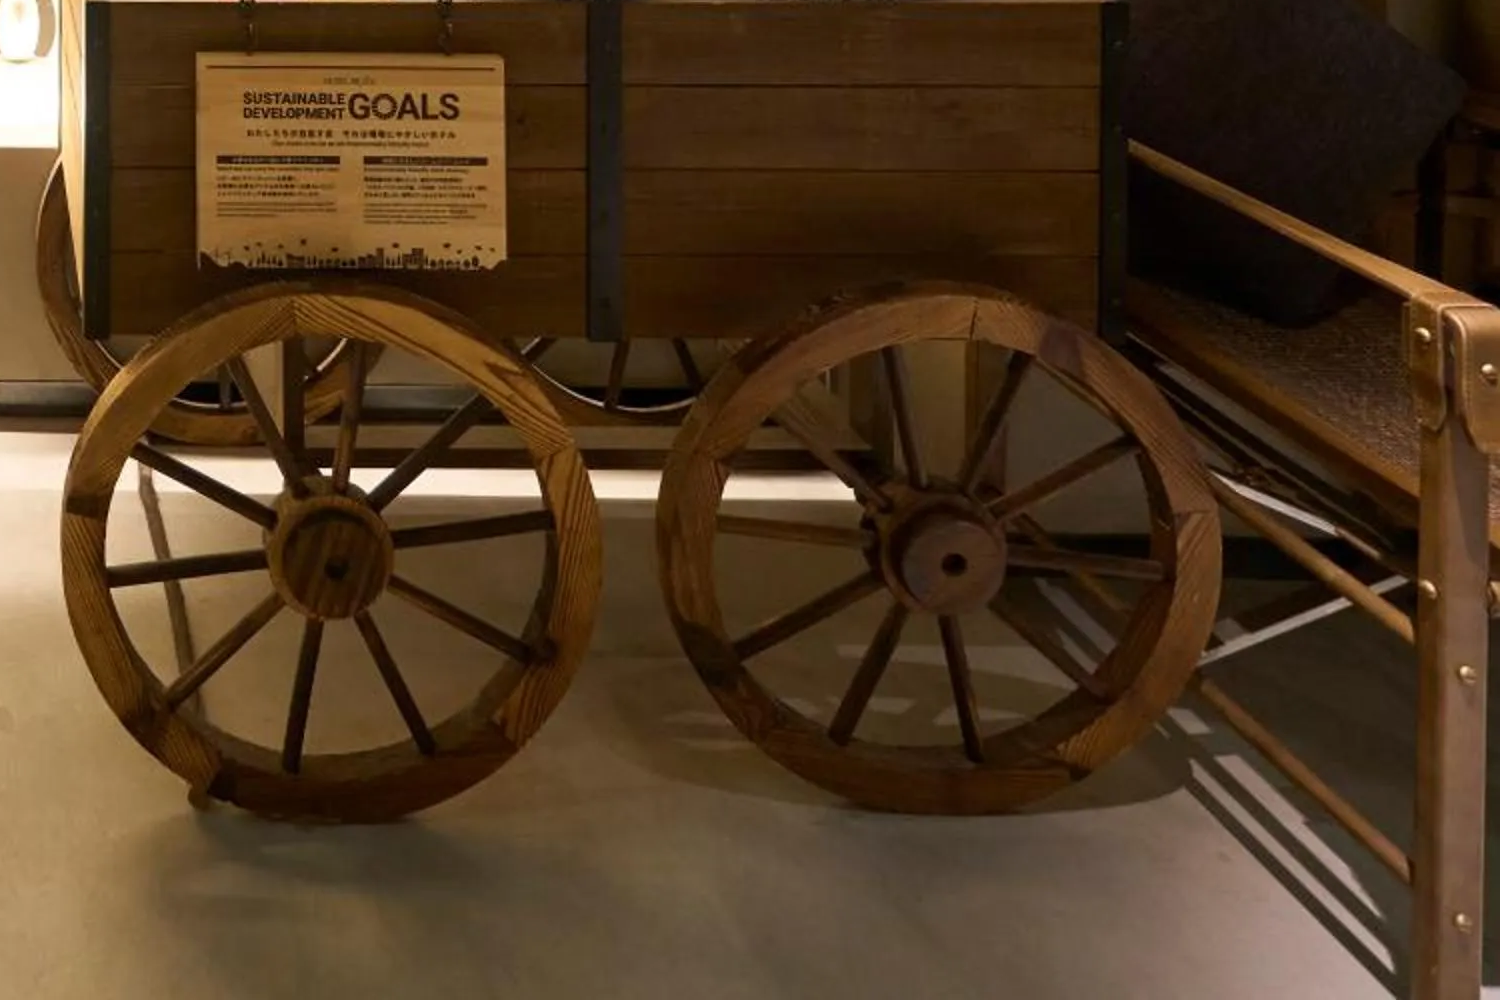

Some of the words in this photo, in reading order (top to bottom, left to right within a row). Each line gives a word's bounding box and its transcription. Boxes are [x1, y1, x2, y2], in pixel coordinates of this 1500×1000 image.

[243, 91, 346, 106] SUSTAINABLE
[243, 107, 346, 121] DEVELOPMENT
[347, 93, 460, 121] GOALS
